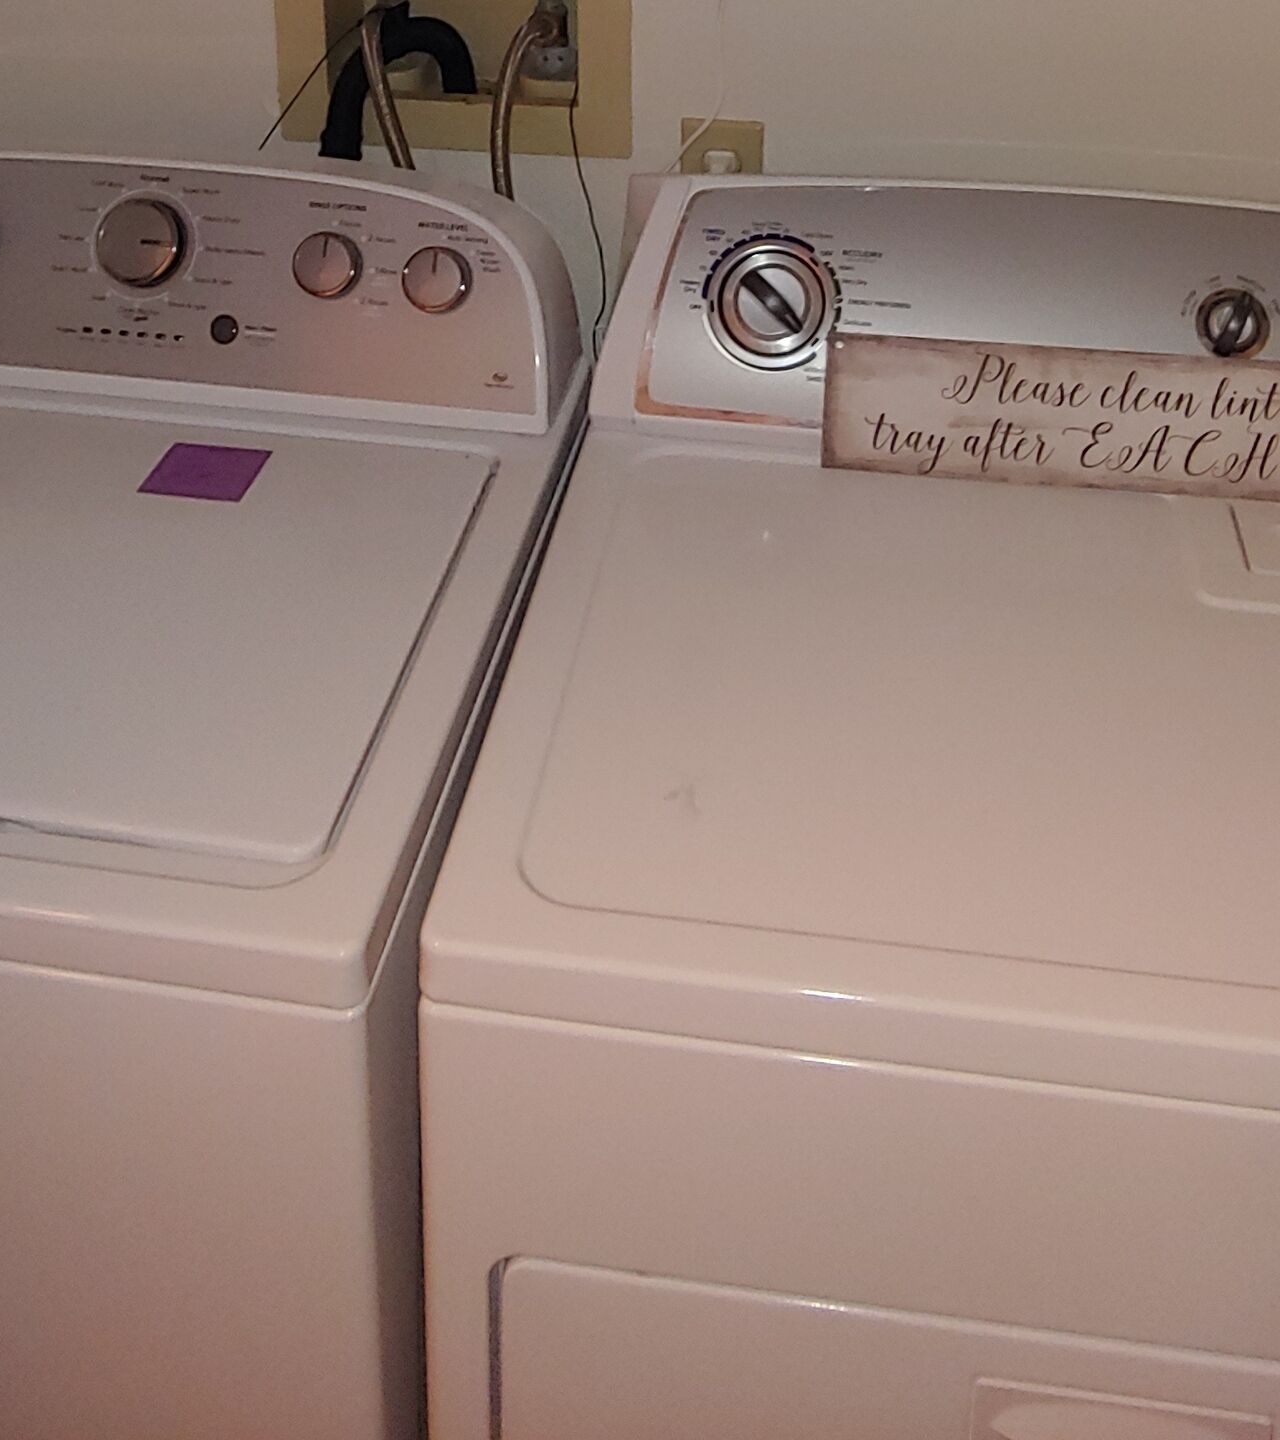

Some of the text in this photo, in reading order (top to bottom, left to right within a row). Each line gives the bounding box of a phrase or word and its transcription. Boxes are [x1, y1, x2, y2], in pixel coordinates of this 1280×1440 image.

[941, 353, 1092, 410] Please
[1099, 370, 1204, 419] clean
[864, 412, 950, 474] tray
[962, 413, 1056, 475] after
